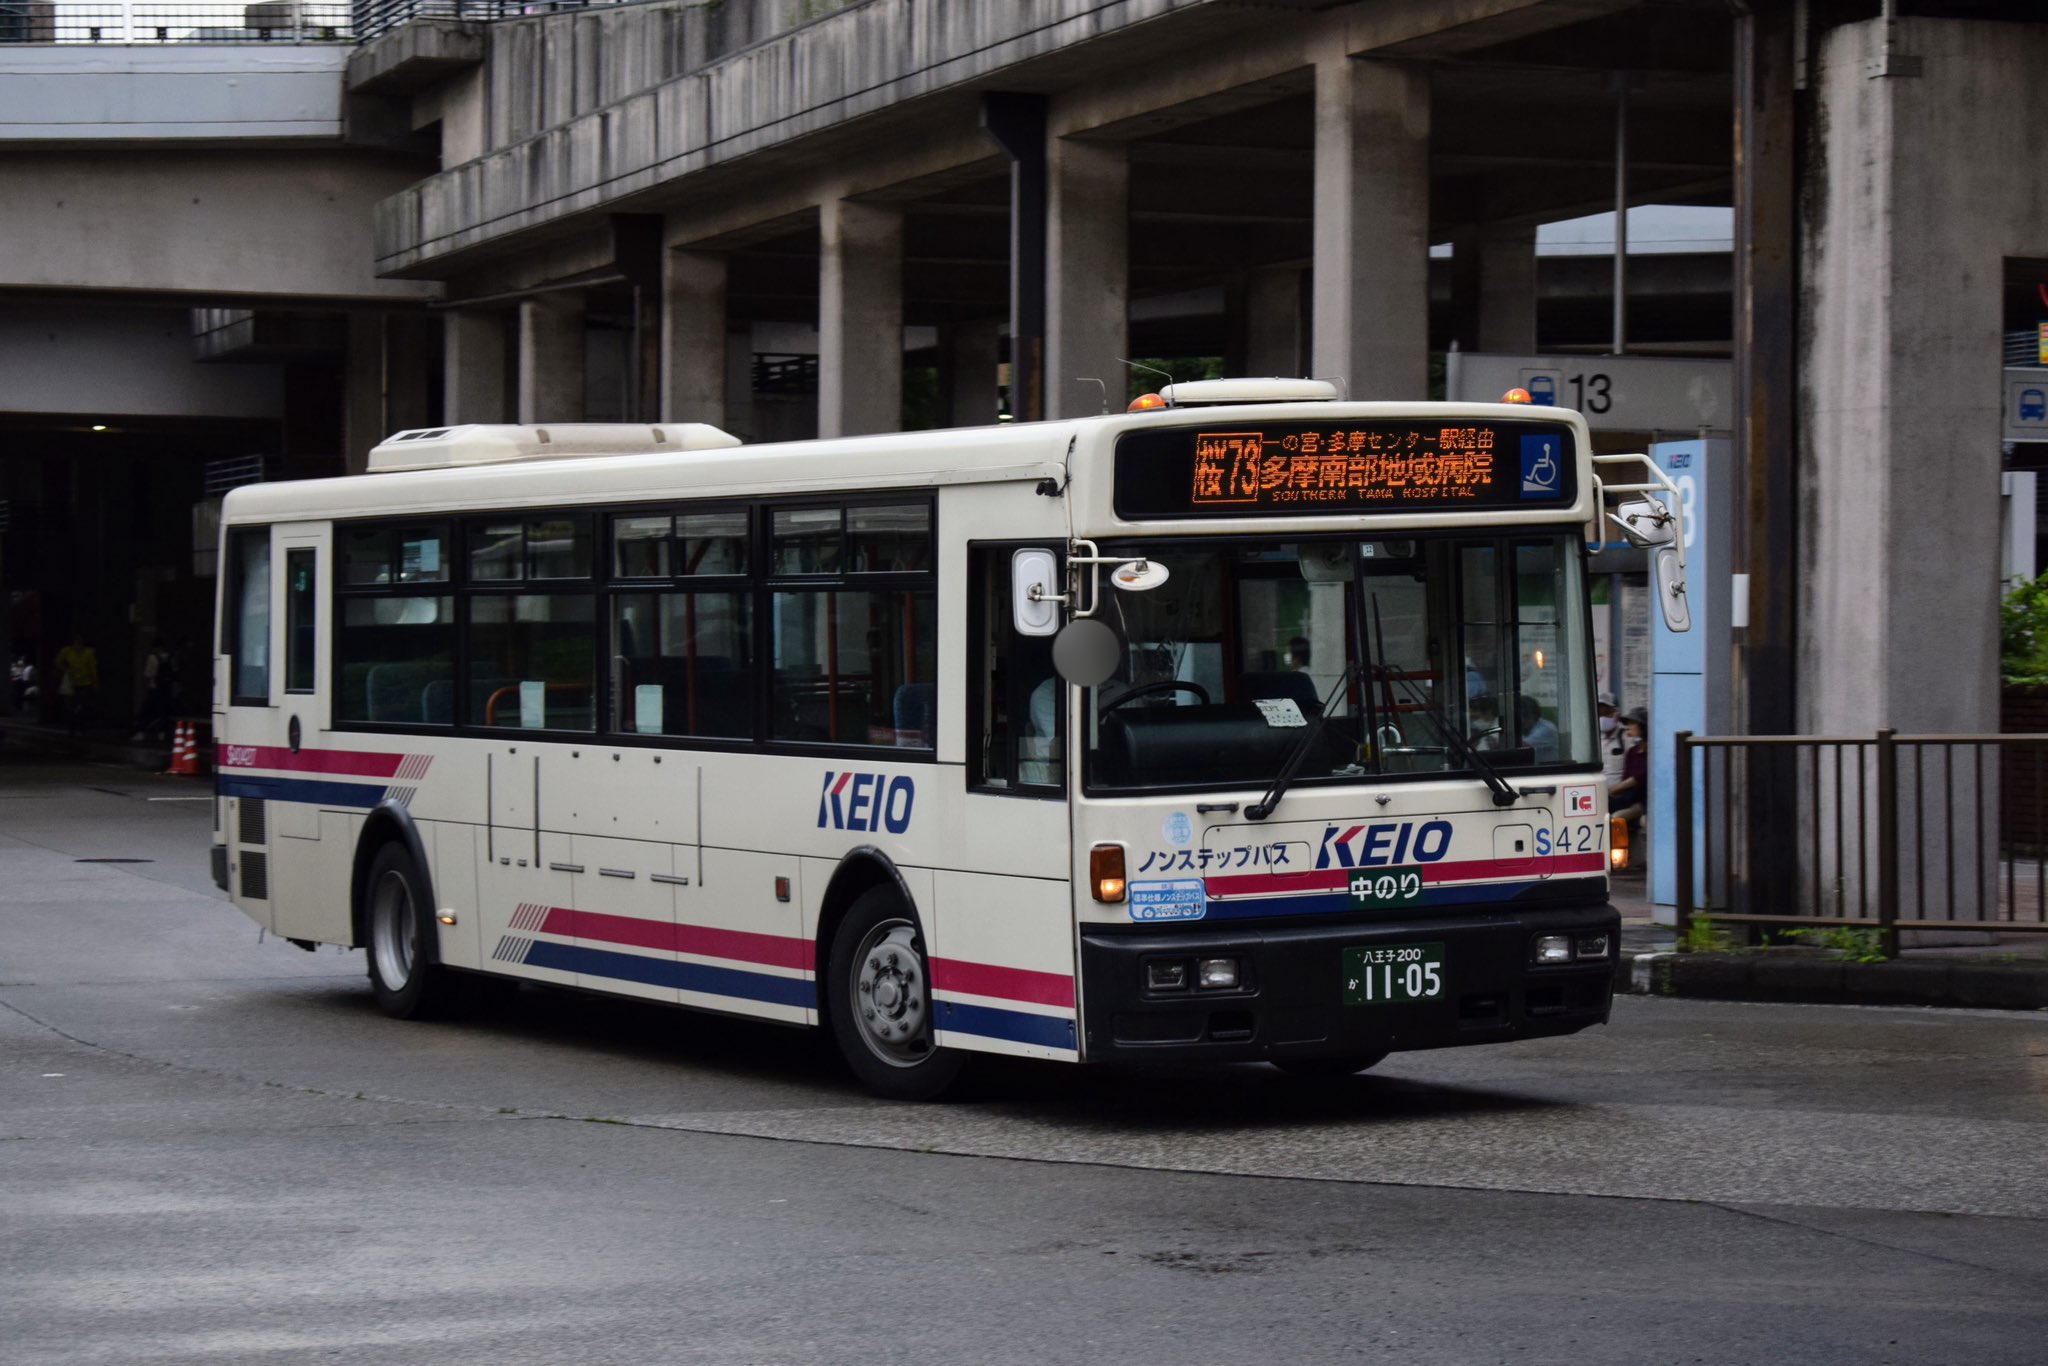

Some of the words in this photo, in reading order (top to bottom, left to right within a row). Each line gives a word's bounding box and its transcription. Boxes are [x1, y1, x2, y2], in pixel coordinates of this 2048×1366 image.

[1568, 373, 1612, 414] 13
[1261, 452, 1494, 489] 多摩南部地域病院
[1272, 490, 1347, 501] SOUTHERN
[1358, 489, 1394, 500] TAMA
[1402, 487, 1476, 498] HOSPITAL
[817, 771, 915, 834] KEIO
[1138, 844, 1290, 873] ノンステップバス
[1315, 820, 1453, 869] KEIO
[1350, 873, 1420, 902] 中のり
[1348, 978, 1360, 990] か
[1366, 962, 1441, 1000] 11-05
